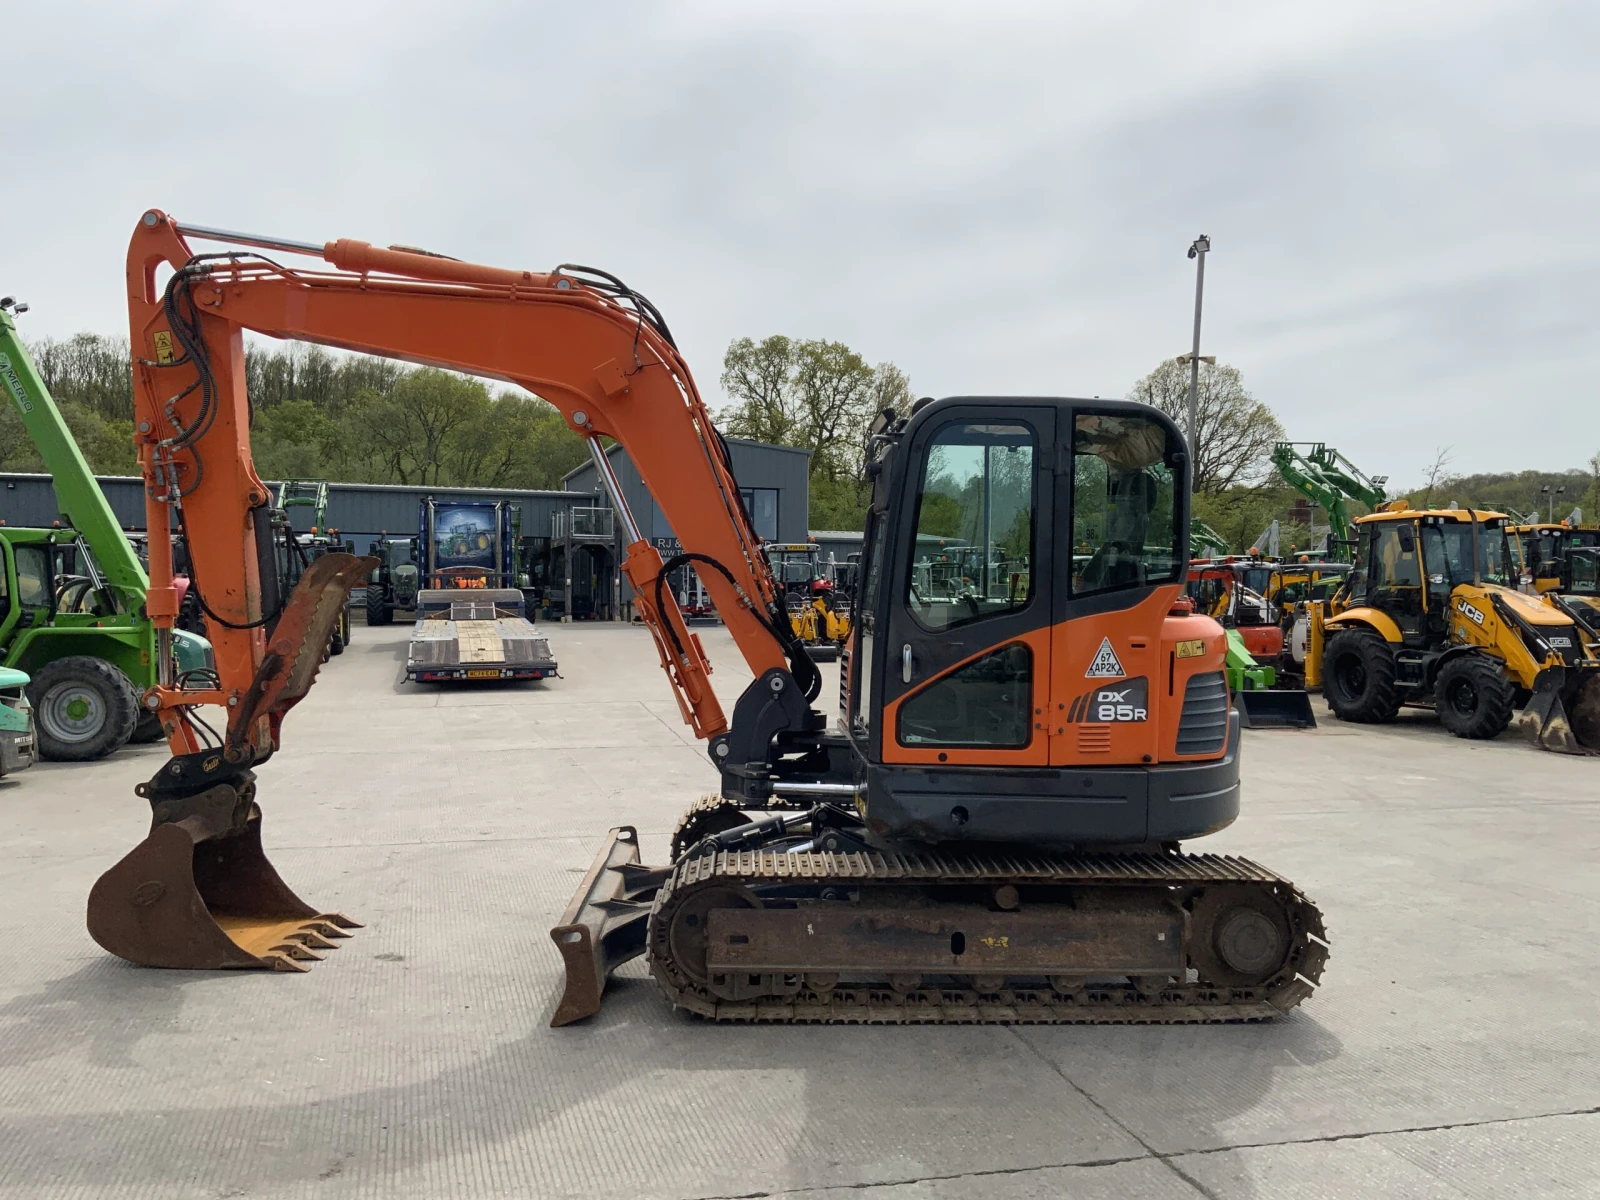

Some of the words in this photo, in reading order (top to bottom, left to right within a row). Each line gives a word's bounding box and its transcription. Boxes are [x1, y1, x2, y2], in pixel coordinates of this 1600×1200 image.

[7, 370, 33, 411] MERLO
[657, 538, 672, 548] RJ
[1457, 601, 1485, 624] JCB
[1101, 653, 1112, 662] 67
[1095, 662, 1117, 672] AP2K
[1097, 688, 1133, 702] DX
[1098, 705, 1147, 721] 85R
